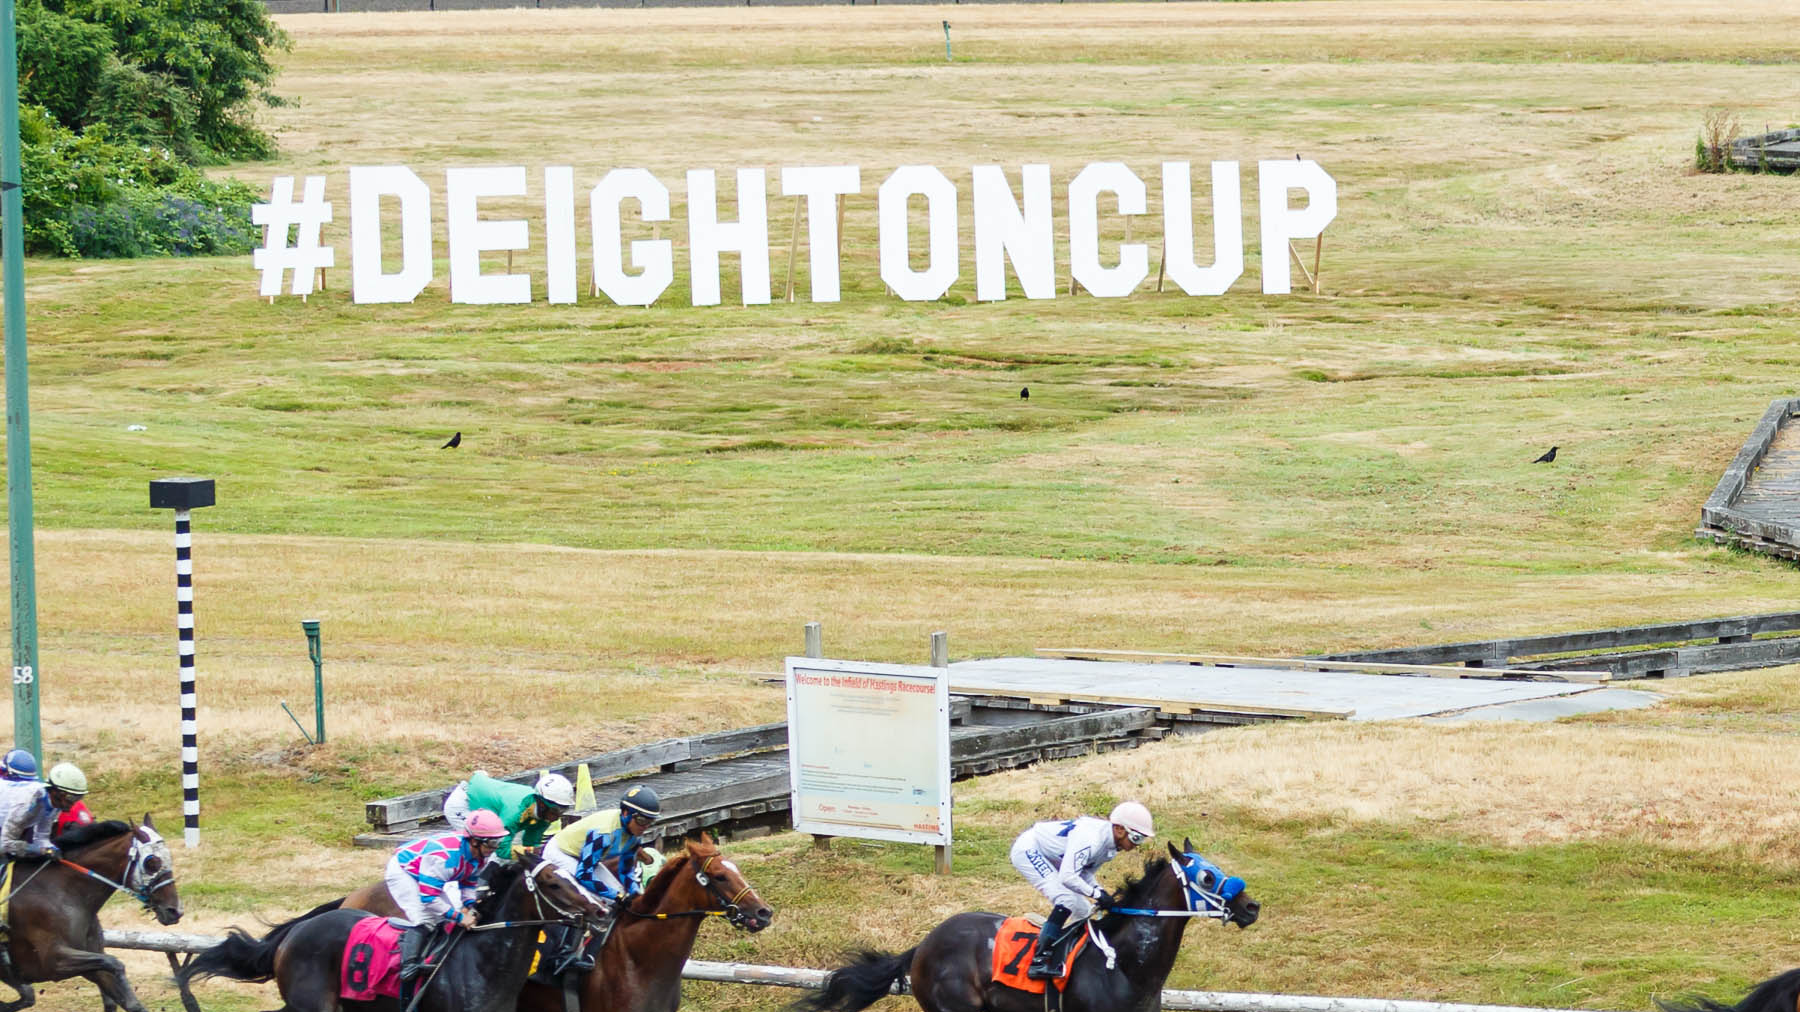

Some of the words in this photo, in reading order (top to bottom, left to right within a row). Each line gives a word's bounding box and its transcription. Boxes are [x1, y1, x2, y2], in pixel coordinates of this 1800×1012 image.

[251, 160, 1338, 305] #DEIGHTONCUP
[14, 666, 34, 684] 58
[794, 673, 822, 686] Welcome
[823, 677, 830, 686] to
[831, 676, 841, 687] the
[862, 677, 871, 689] of
[870, 679, 897, 694] Hastings
[347, 942, 373, 992] 8
[1003, 931, 1039, 976] 7
